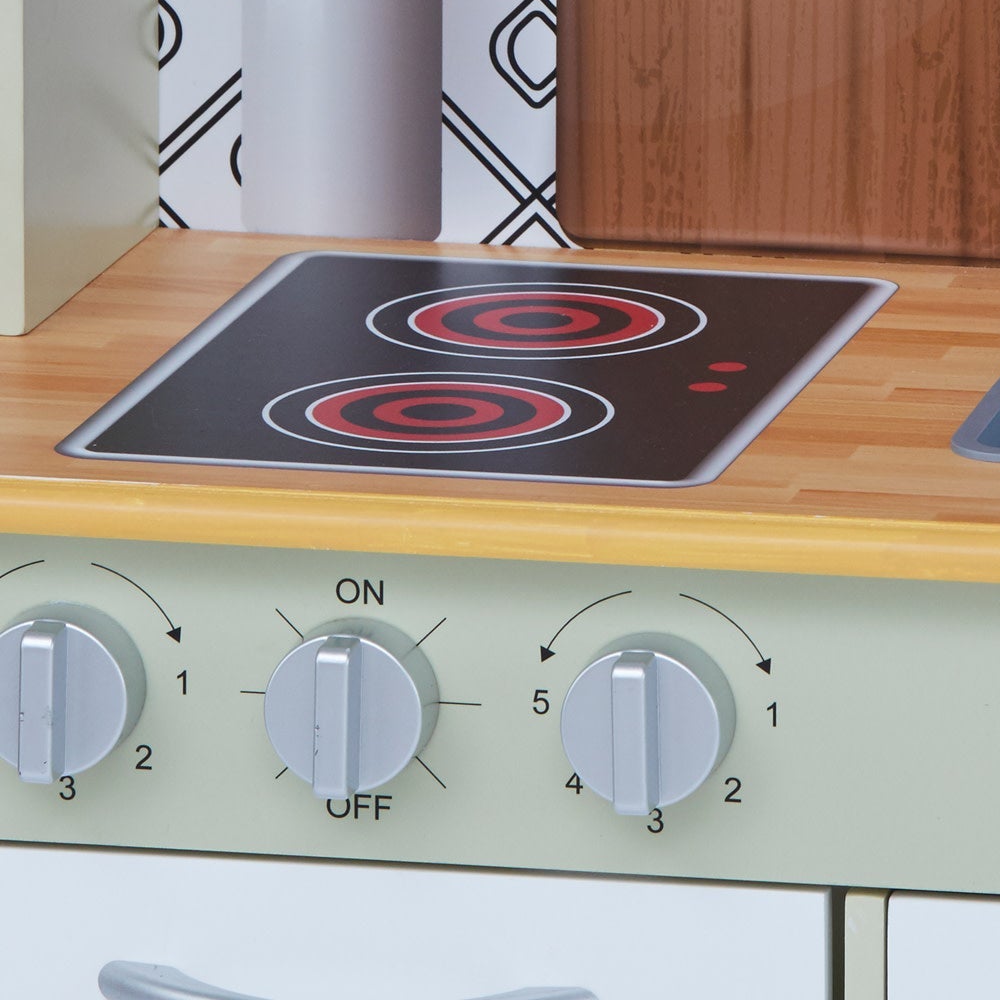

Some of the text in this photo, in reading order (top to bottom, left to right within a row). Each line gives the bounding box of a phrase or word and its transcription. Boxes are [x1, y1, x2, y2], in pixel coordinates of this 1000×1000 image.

[335, 577, 384, 606] ON
[176, 669, 187, 696] 1
[532, 689, 550, 715] 5
[766, 701, 777, 728] 1
[135, 744, 153, 771] 2
[59, 775, 77, 801] 3
[565, 772, 584, 795] 4
[724, 776, 742, 803] 2
[326, 793, 393, 821] OFF
[646, 807, 665, 834] 3
